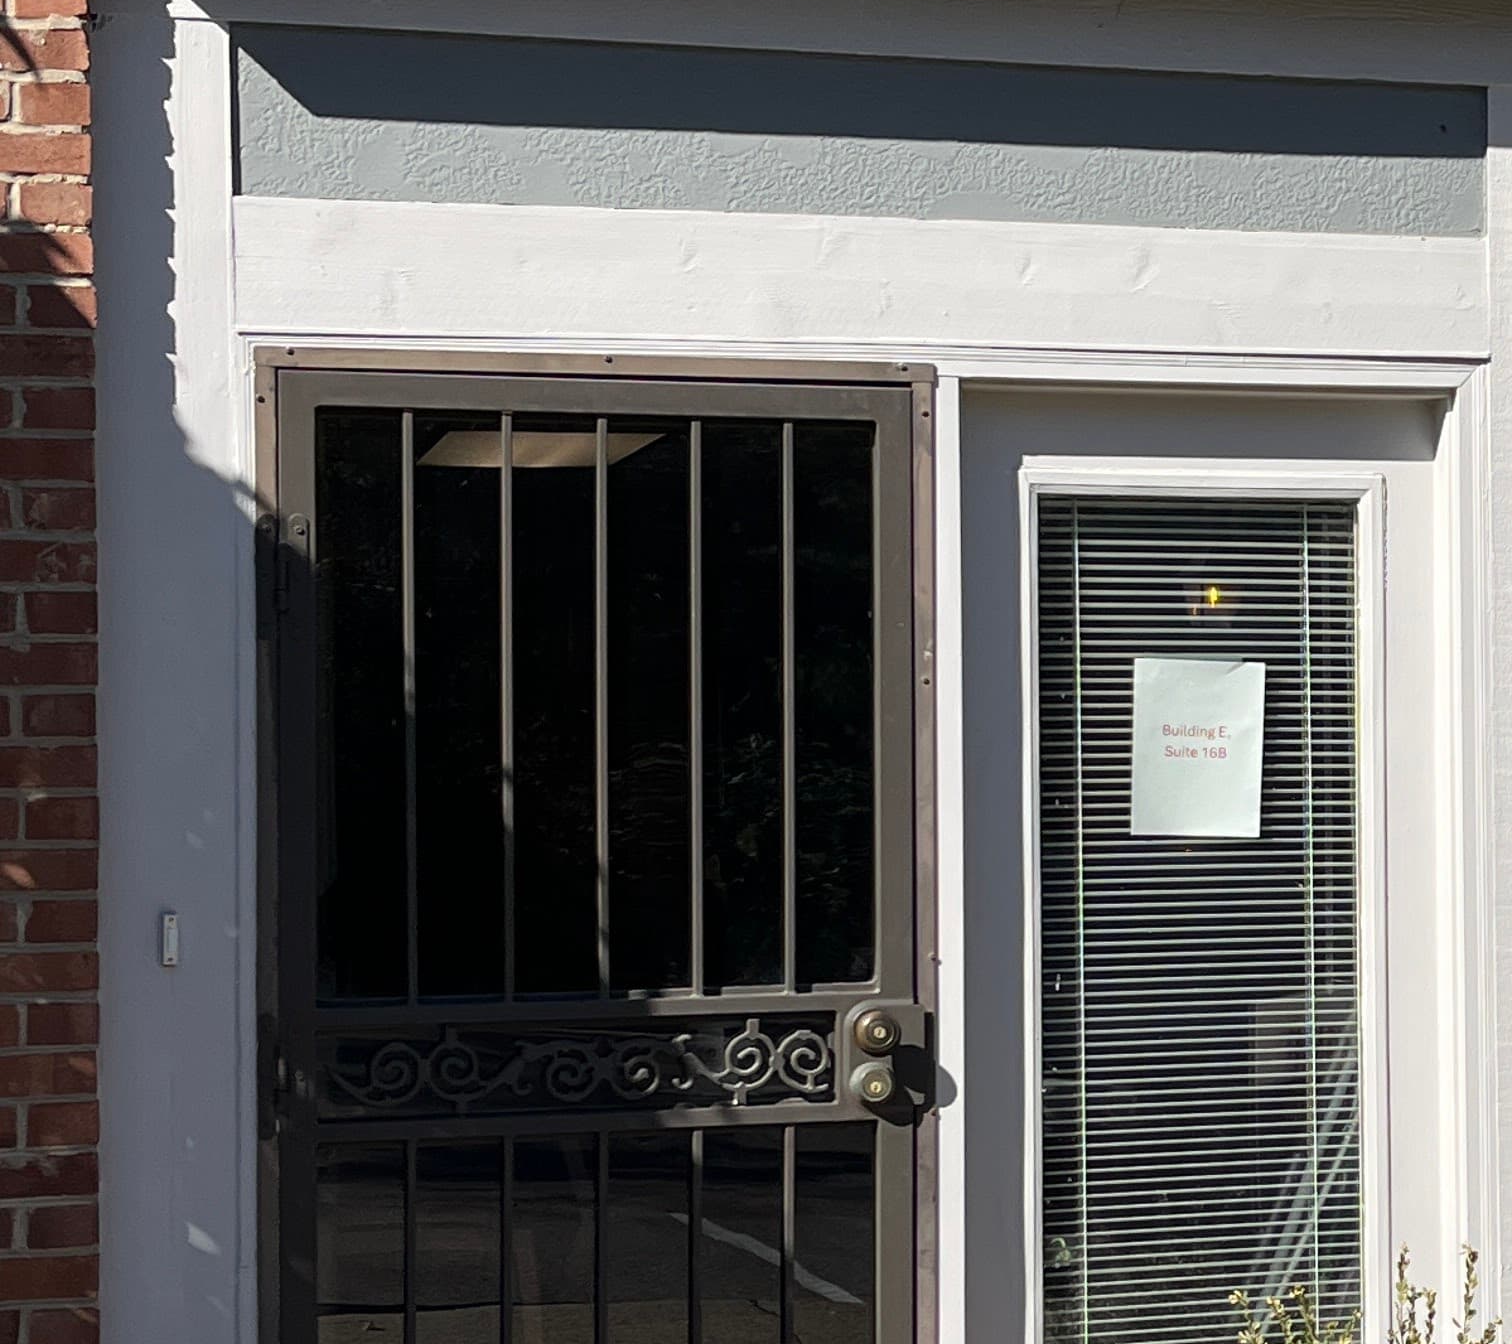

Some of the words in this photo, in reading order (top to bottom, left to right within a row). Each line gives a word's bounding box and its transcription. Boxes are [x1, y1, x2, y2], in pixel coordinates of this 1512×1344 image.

[1162, 724, 1215, 740] Building
[1164, 745, 1199, 758] Suite
[1202, 746, 1227, 759] 16B
